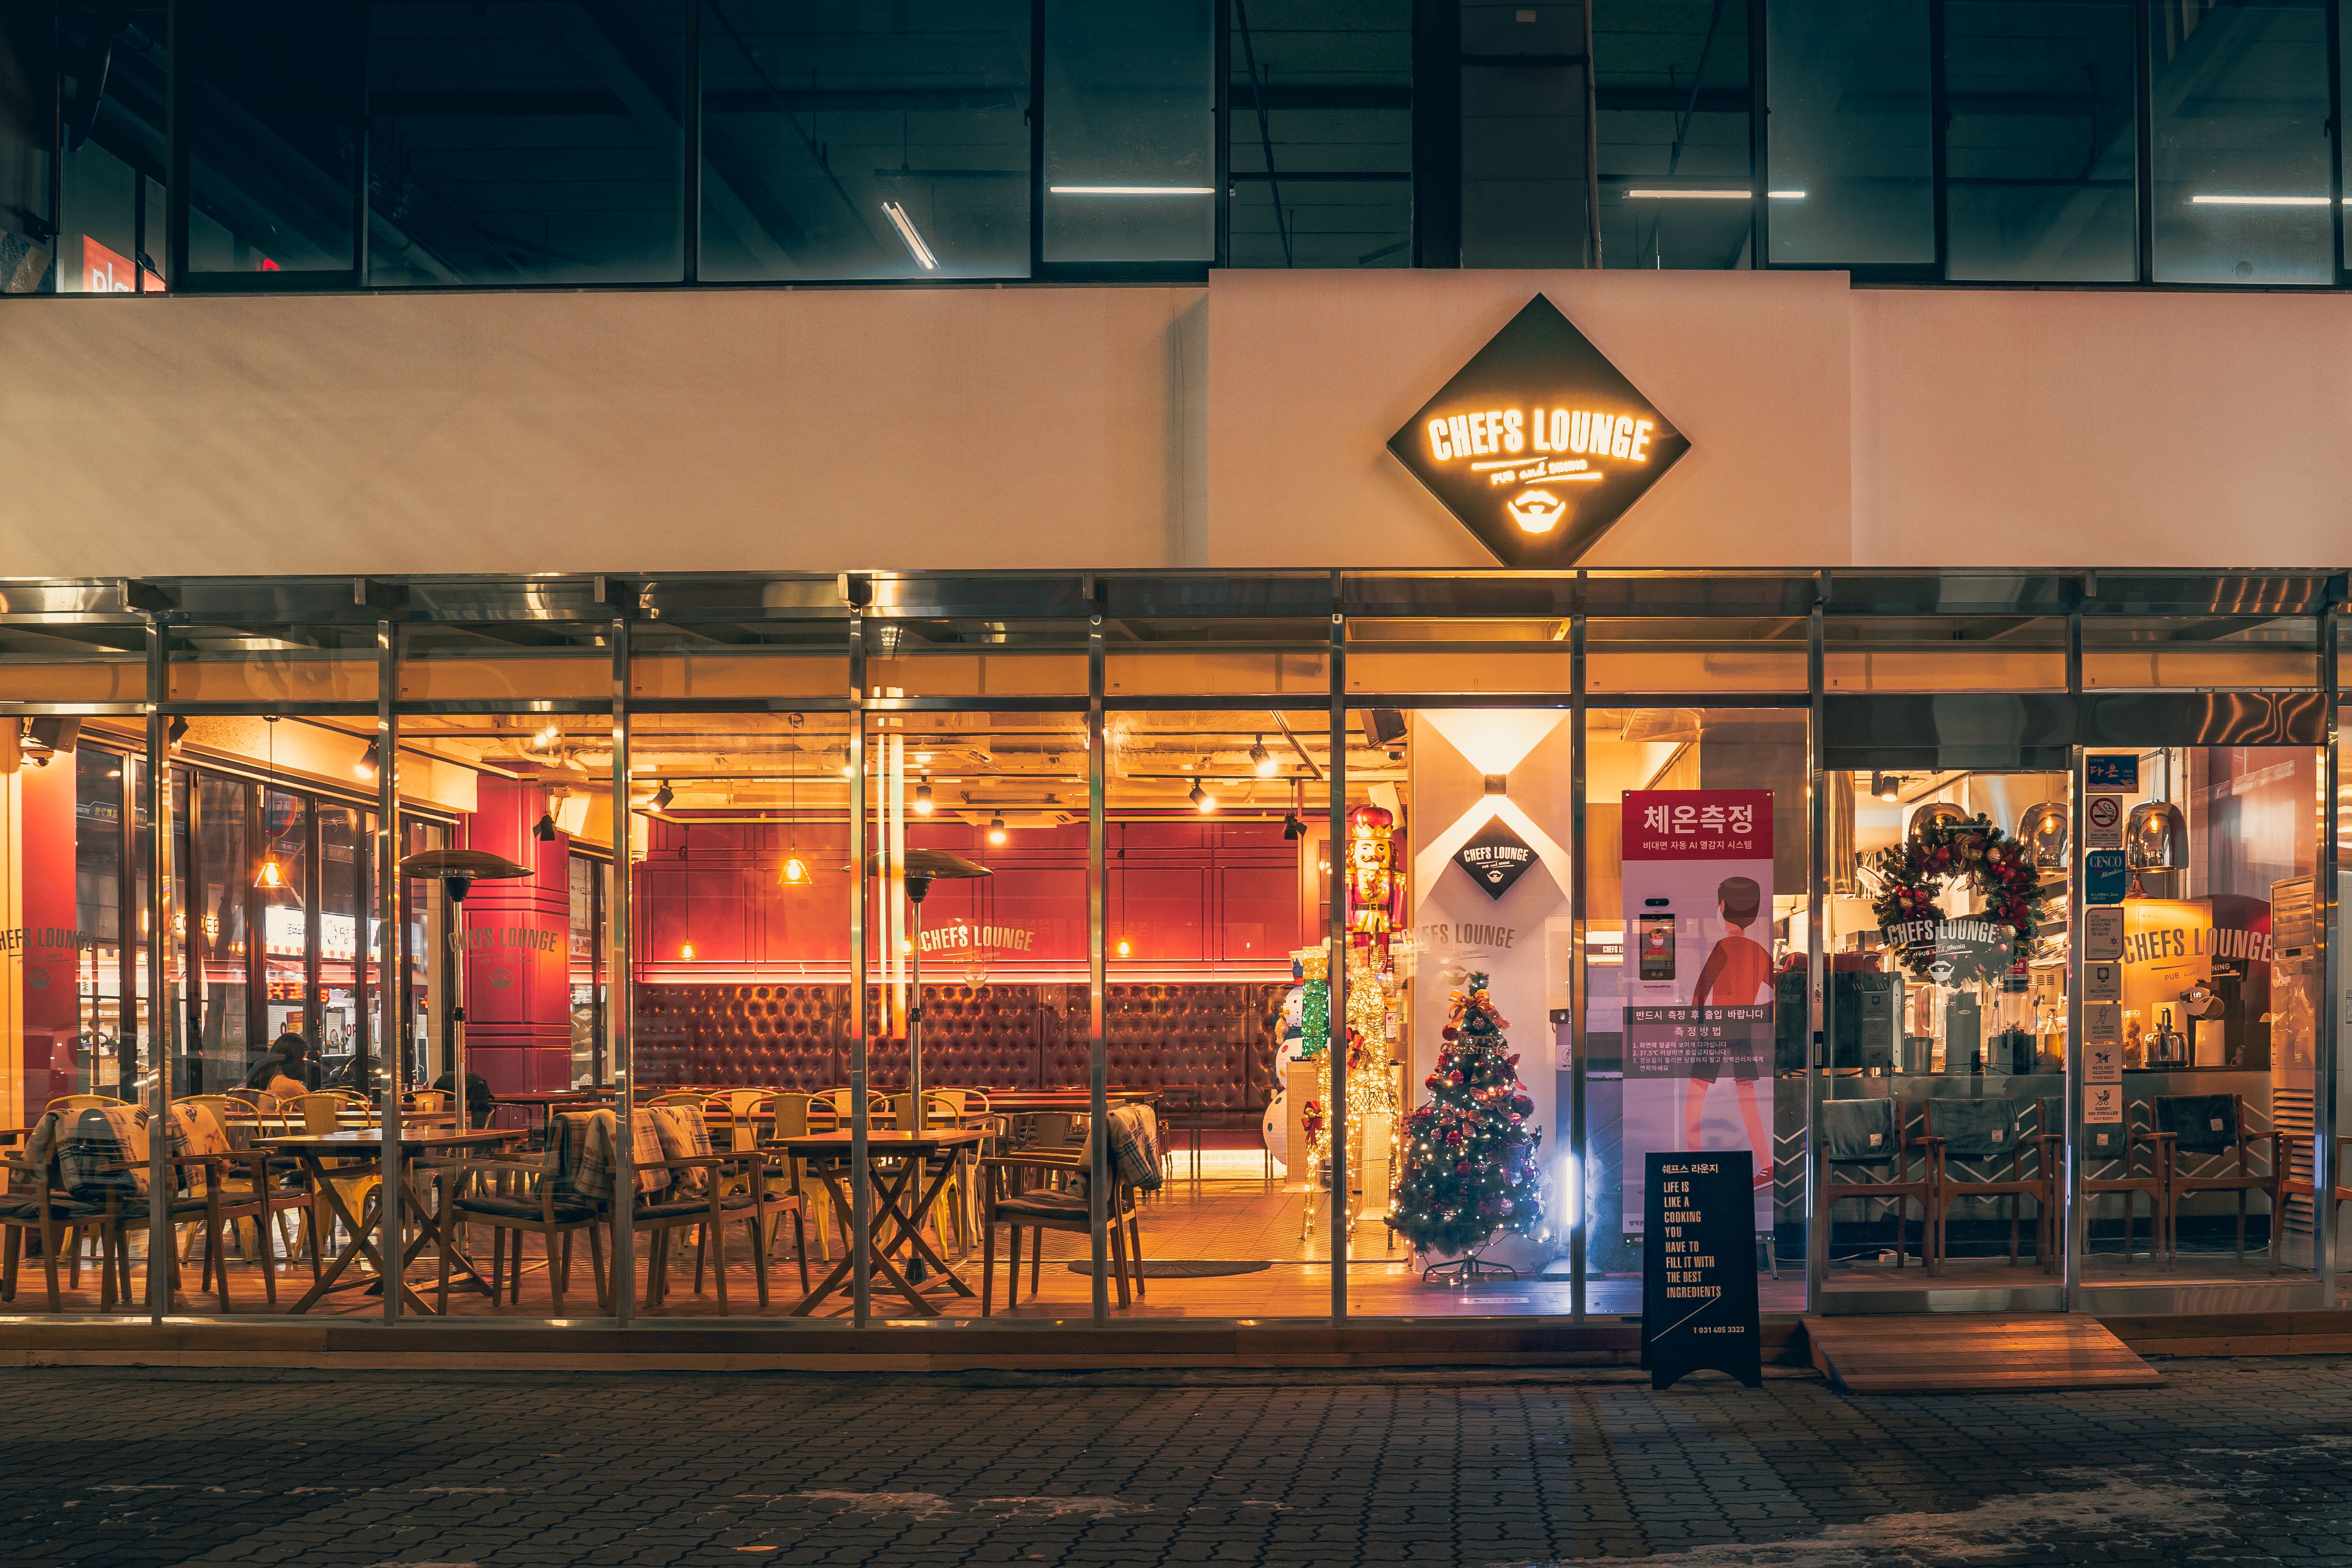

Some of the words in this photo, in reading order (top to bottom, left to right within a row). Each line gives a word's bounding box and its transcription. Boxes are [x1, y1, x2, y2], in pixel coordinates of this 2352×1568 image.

[1428, 410, 1523, 461] CHEFS
[1534, 409, 1652, 462] LOUNGE
[1491, 470, 1515, 485] PUB
[1519, 462, 1547, 479] and
[1643, 805, 1753, 834] 체온측정
[1643, 841, 1668, 850] 비대면
[1670, 841, 1687, 850] 자동
[1699, 841, 1724, 850] 열감지
[1727, 840, 1753, 850] 시스템
[1463, 847, 1491, 862] CHEFS
[1494, 847, 1529, 861] LOUNGE
[2090, 856, 2122, 868] CESCO
[1456, 924, 1515, 948] LOUNGE
[1887, 919, 1933, 945] CHEFS
[1938, 919, 1998, 944] LOUNGE
[448, 928, 494, 952] CHEFS
[501, 928, 558, 952] LOUNGE
[920, 925, 968, 952] CHEFS
[974, 926, 1034, 951] LOUNGE
[2124, 928, 2184, 964] CHEFS
[2195, 928, 2271, 963] LOUNGE
[2164, 972, 2179, 981] PUB
[2212, 963, 2230, 971] NING
[1636, 1011, 1662, 1020] 반드시
[1667, 1010, 1685, 1020] 측정
[1690, 1010, 1699, 1020] 후
[1705, 1010, 1722, 1020] 출입
[1728, 1009, 1764, 1019] 바랍니다
[1662, 1165, 1689, 1174] 쉐프스
[1691, 1164, 1718, 1174] 라운지
[1664, 1182, 1679, 1193] LIFE
[1682, 1181, 1689, 1192] IS
[1664, 1197, 1681, 1207] LIKE
[1684, 1196, 1689, 1207] A
[1664, 1211, 1701, 1223] COOKING
[1665, 1227, 1682, 1237] YOU
[1665, 1241, 1686, 1252] HAVE
[1689, 1241, 1699, 1252] TO
[1666, 1256, 1682, 1268] FILL
[1684, 1256, 1692, 1267] IT
[1694, 1256, 1714, 1267] WITH
[1667, 1272, 1681, 1282] THE
[1683, 1271, 1702, 1282] BEST
[1667, 1286, 1721, 1298] INGREDIENTS
